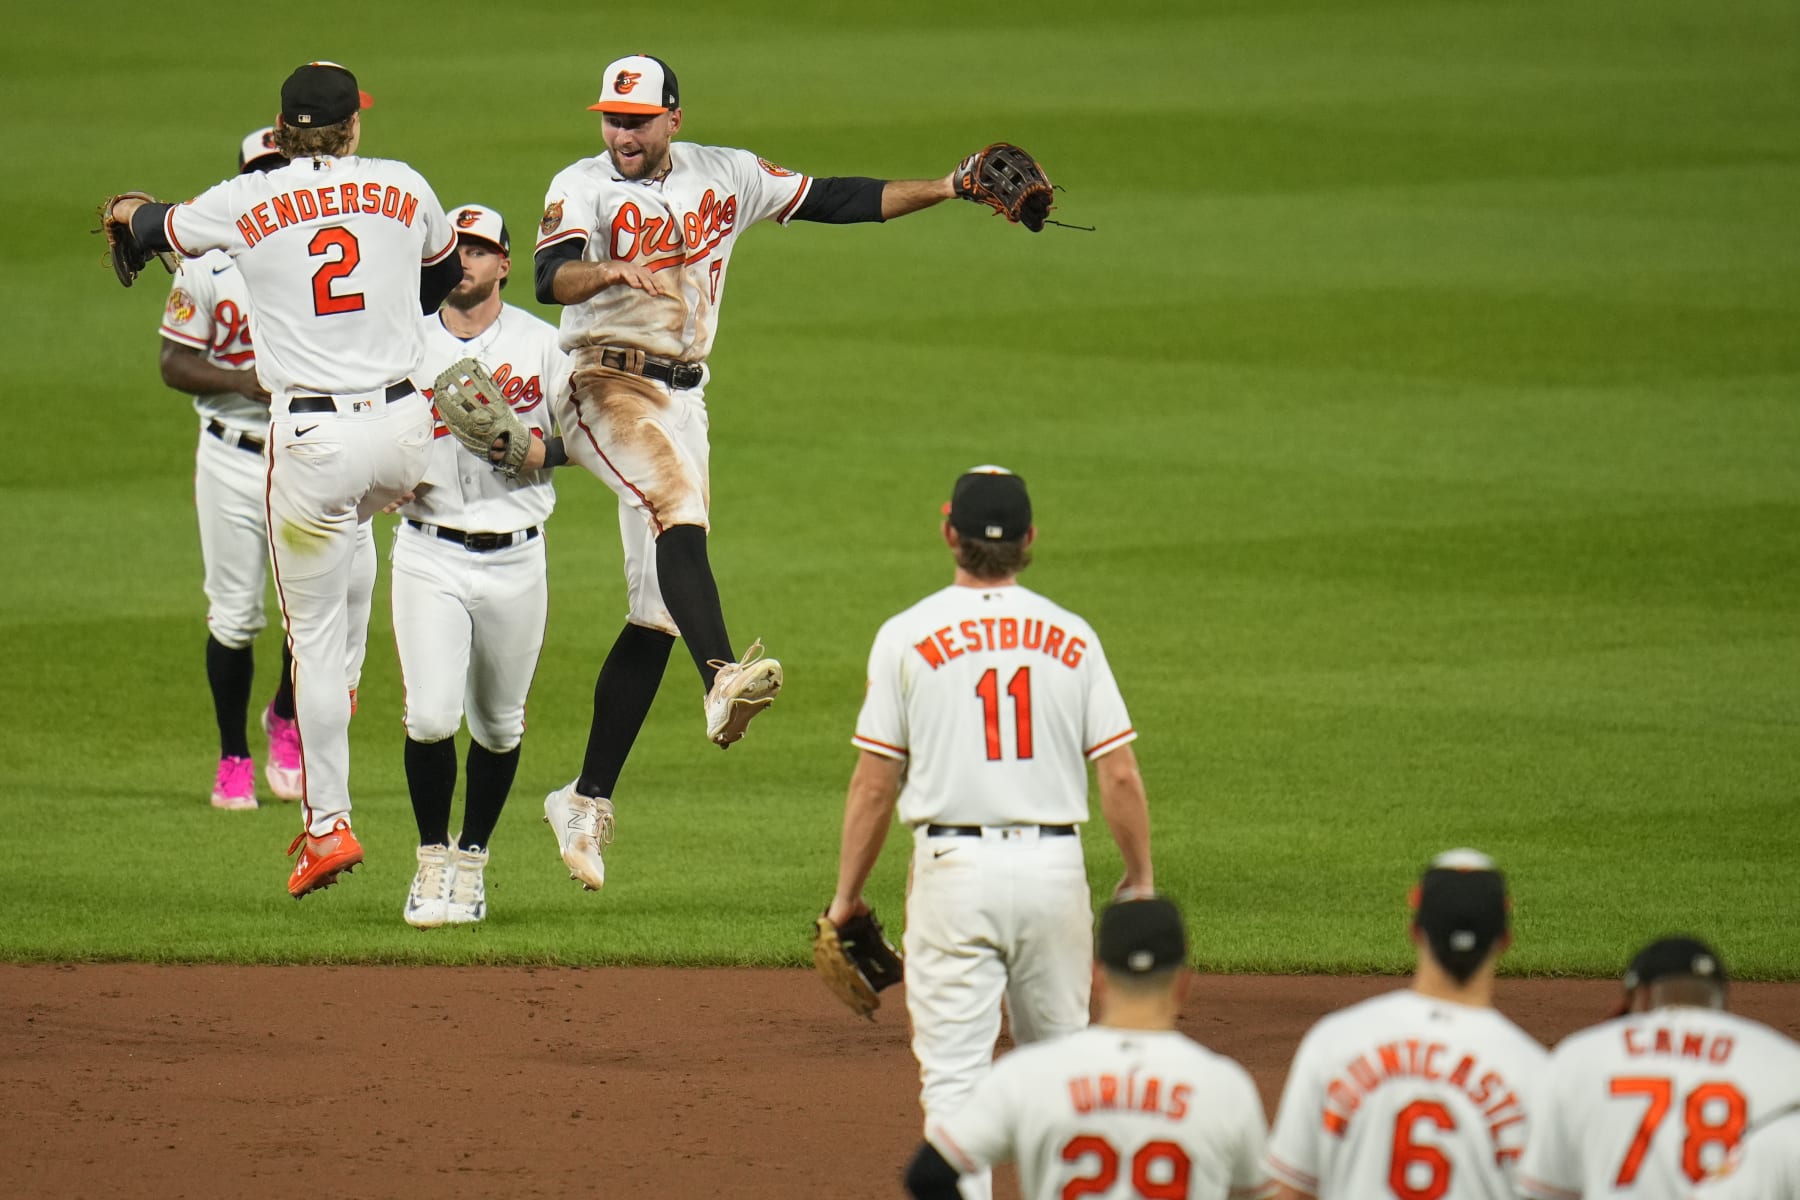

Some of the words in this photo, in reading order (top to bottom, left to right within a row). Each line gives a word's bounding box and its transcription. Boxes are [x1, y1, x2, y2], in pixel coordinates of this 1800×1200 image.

[235, 182, 419, 248] HENDERSON
[307, 225, 366, 316] 2
[914, 617, 1086, 670] WESTBURG
[975, 665, 1033, 761] 11
[1622, 1026, 1735, 1066] CANO
[1068, 1063, 1193, 1123] URÍAS
[1060, 1132, 1193, 1200] 29
[1388, 1097, 1457, 1200] 6
[1608, 1075, 1748, 1189] 78
